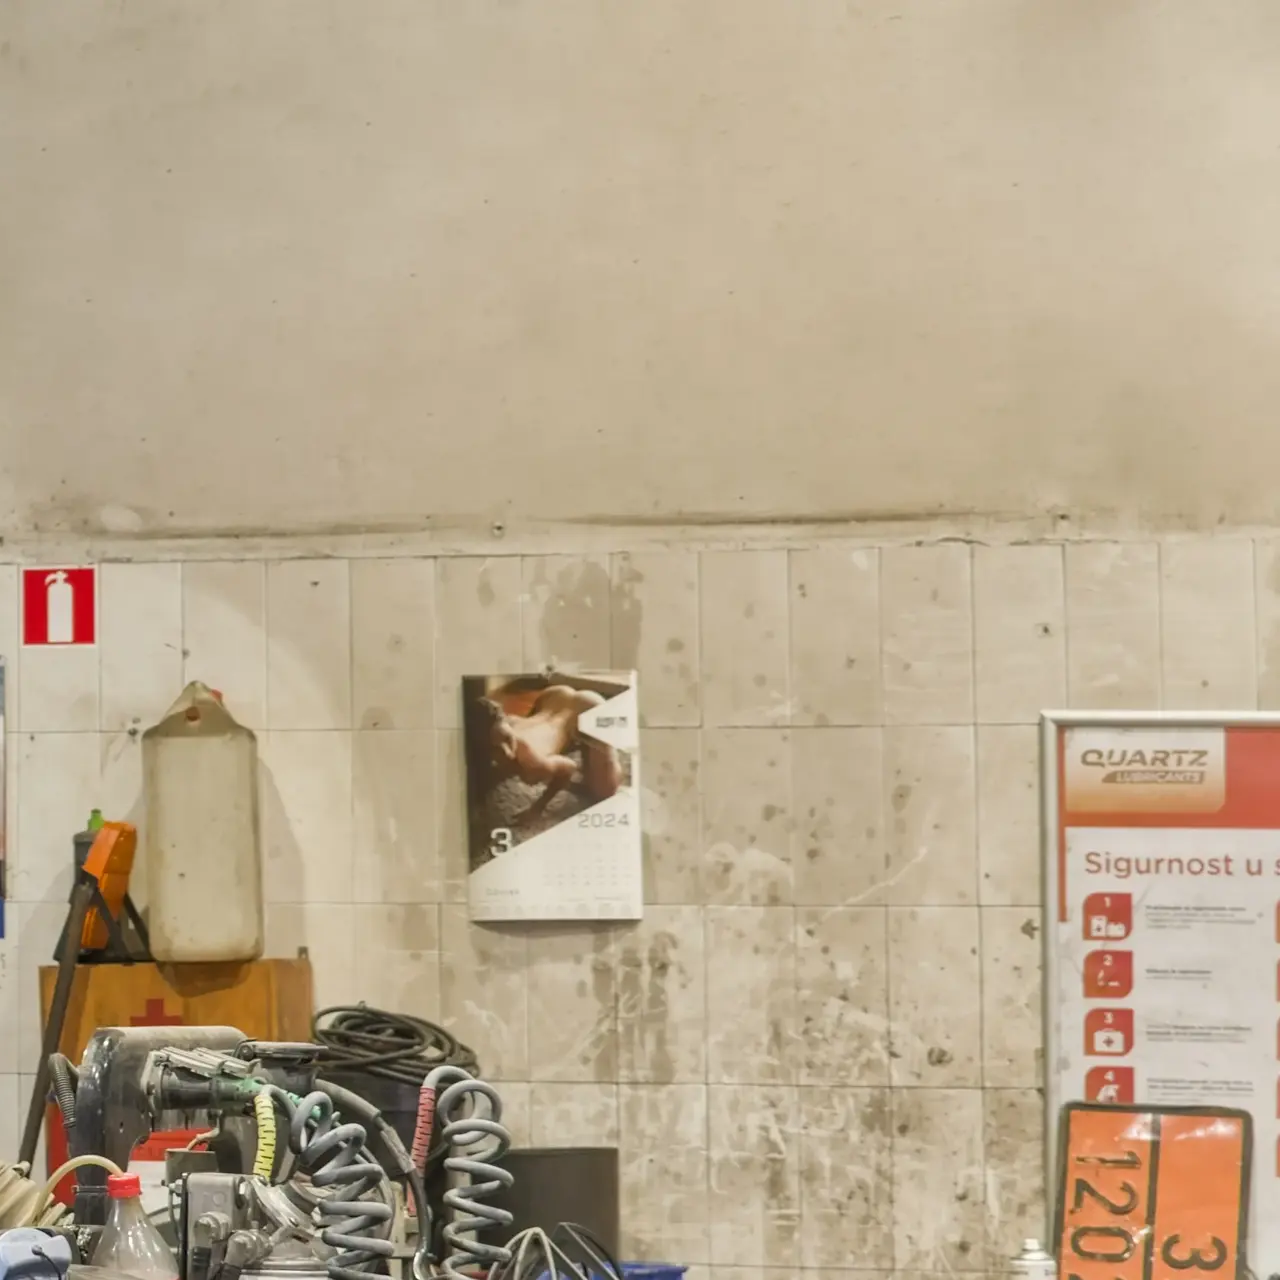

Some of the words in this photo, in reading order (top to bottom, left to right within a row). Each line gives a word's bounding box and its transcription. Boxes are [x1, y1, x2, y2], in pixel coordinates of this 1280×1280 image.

[1080, 749, 1209, 768] QUARTZ
[578, 812, 630, 829] 2024
[490, 828, 513, 857] 3
[1084, 851, 1234, 879] Sigurnost
[1246, 858, 1263, 876] u
[1103, 954, 1113, 966] 2
[1104, 1012, 1113, 1024] 3
[1104, 1070, 1114, 1081] 4
